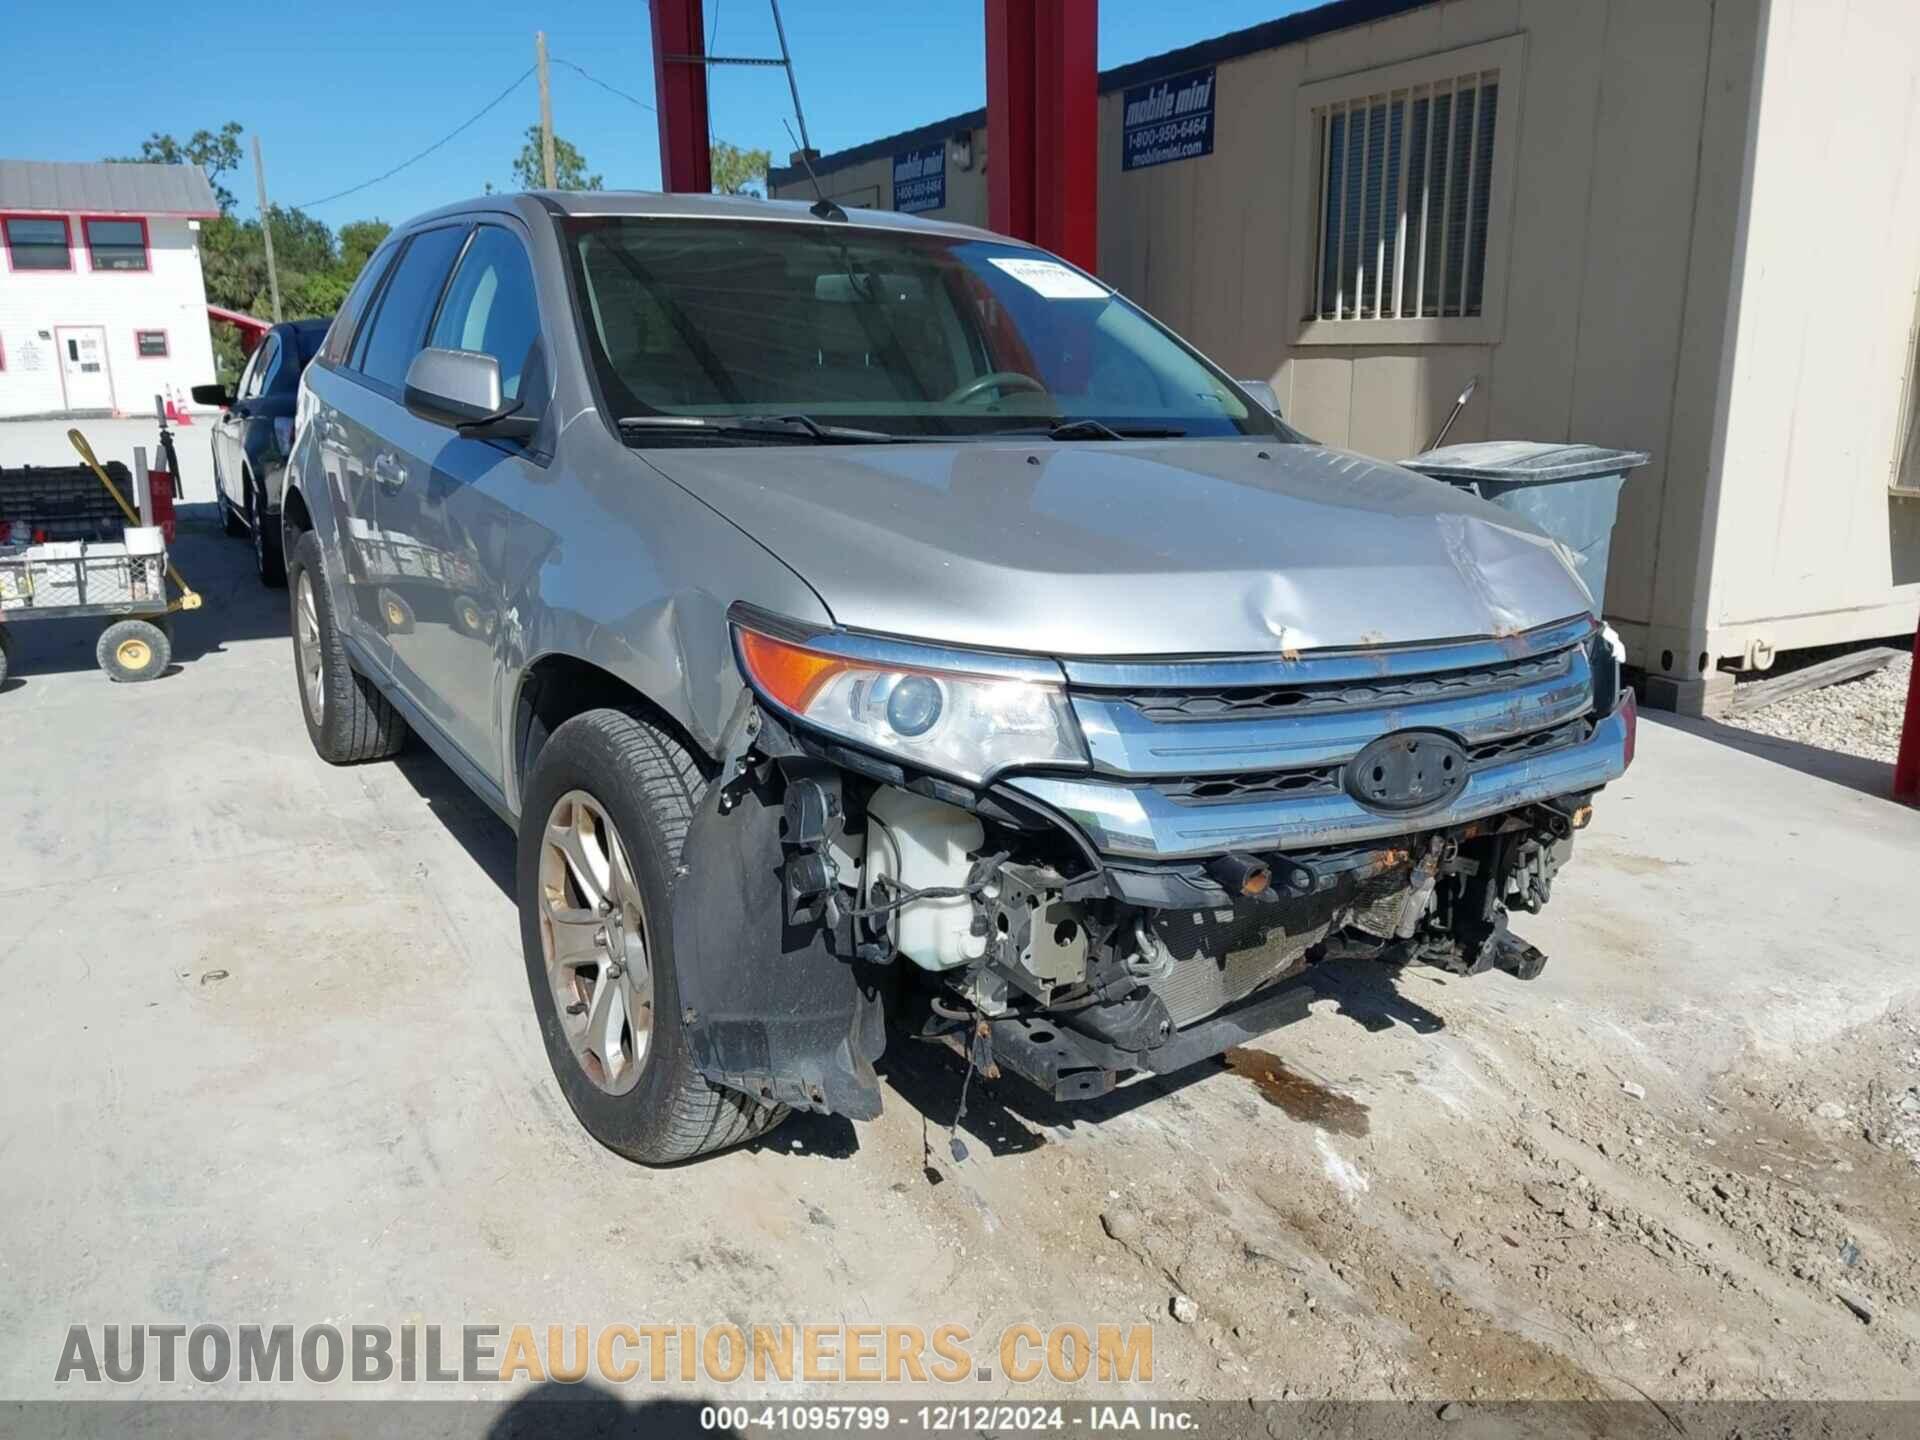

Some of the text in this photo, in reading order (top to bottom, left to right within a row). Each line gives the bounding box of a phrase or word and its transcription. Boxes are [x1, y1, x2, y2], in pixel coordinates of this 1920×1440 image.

[1126, 72, 1214, 126] mobile mini
[1128, 116, 1207, 150] 1-800-950-6464
